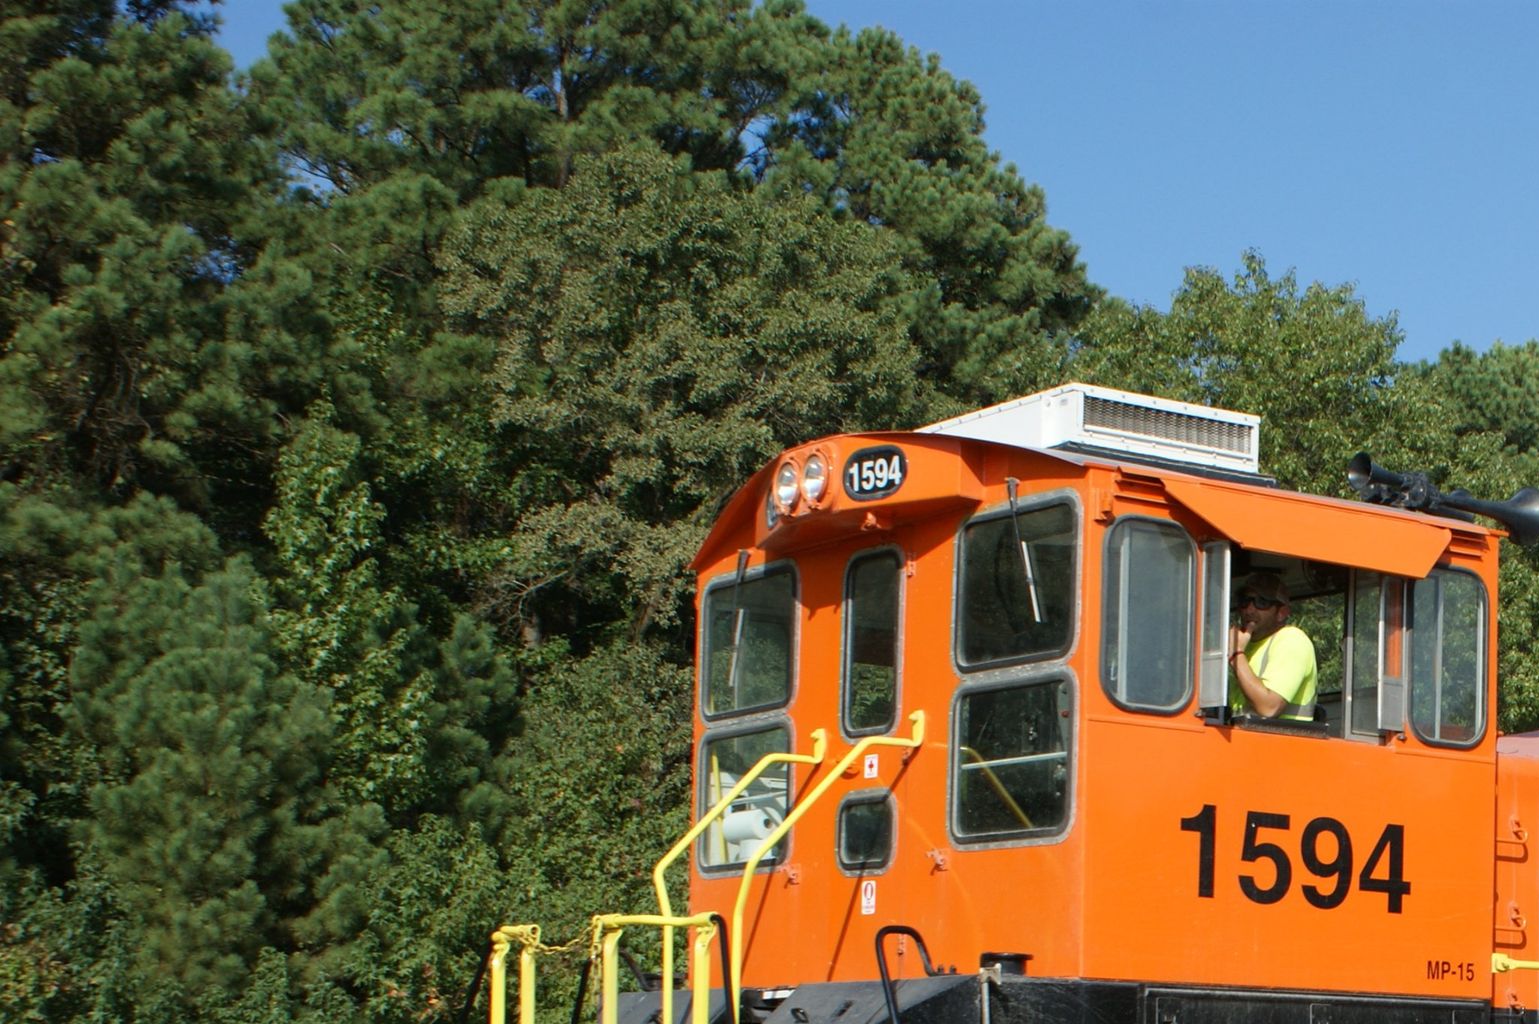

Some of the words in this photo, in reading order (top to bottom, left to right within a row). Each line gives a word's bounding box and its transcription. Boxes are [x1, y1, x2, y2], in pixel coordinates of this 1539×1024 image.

[849, 455, 902, 492] 1594
[1181, 804, 1411, 914] 1594
[1427, 960, 1474, 981] MP-15
